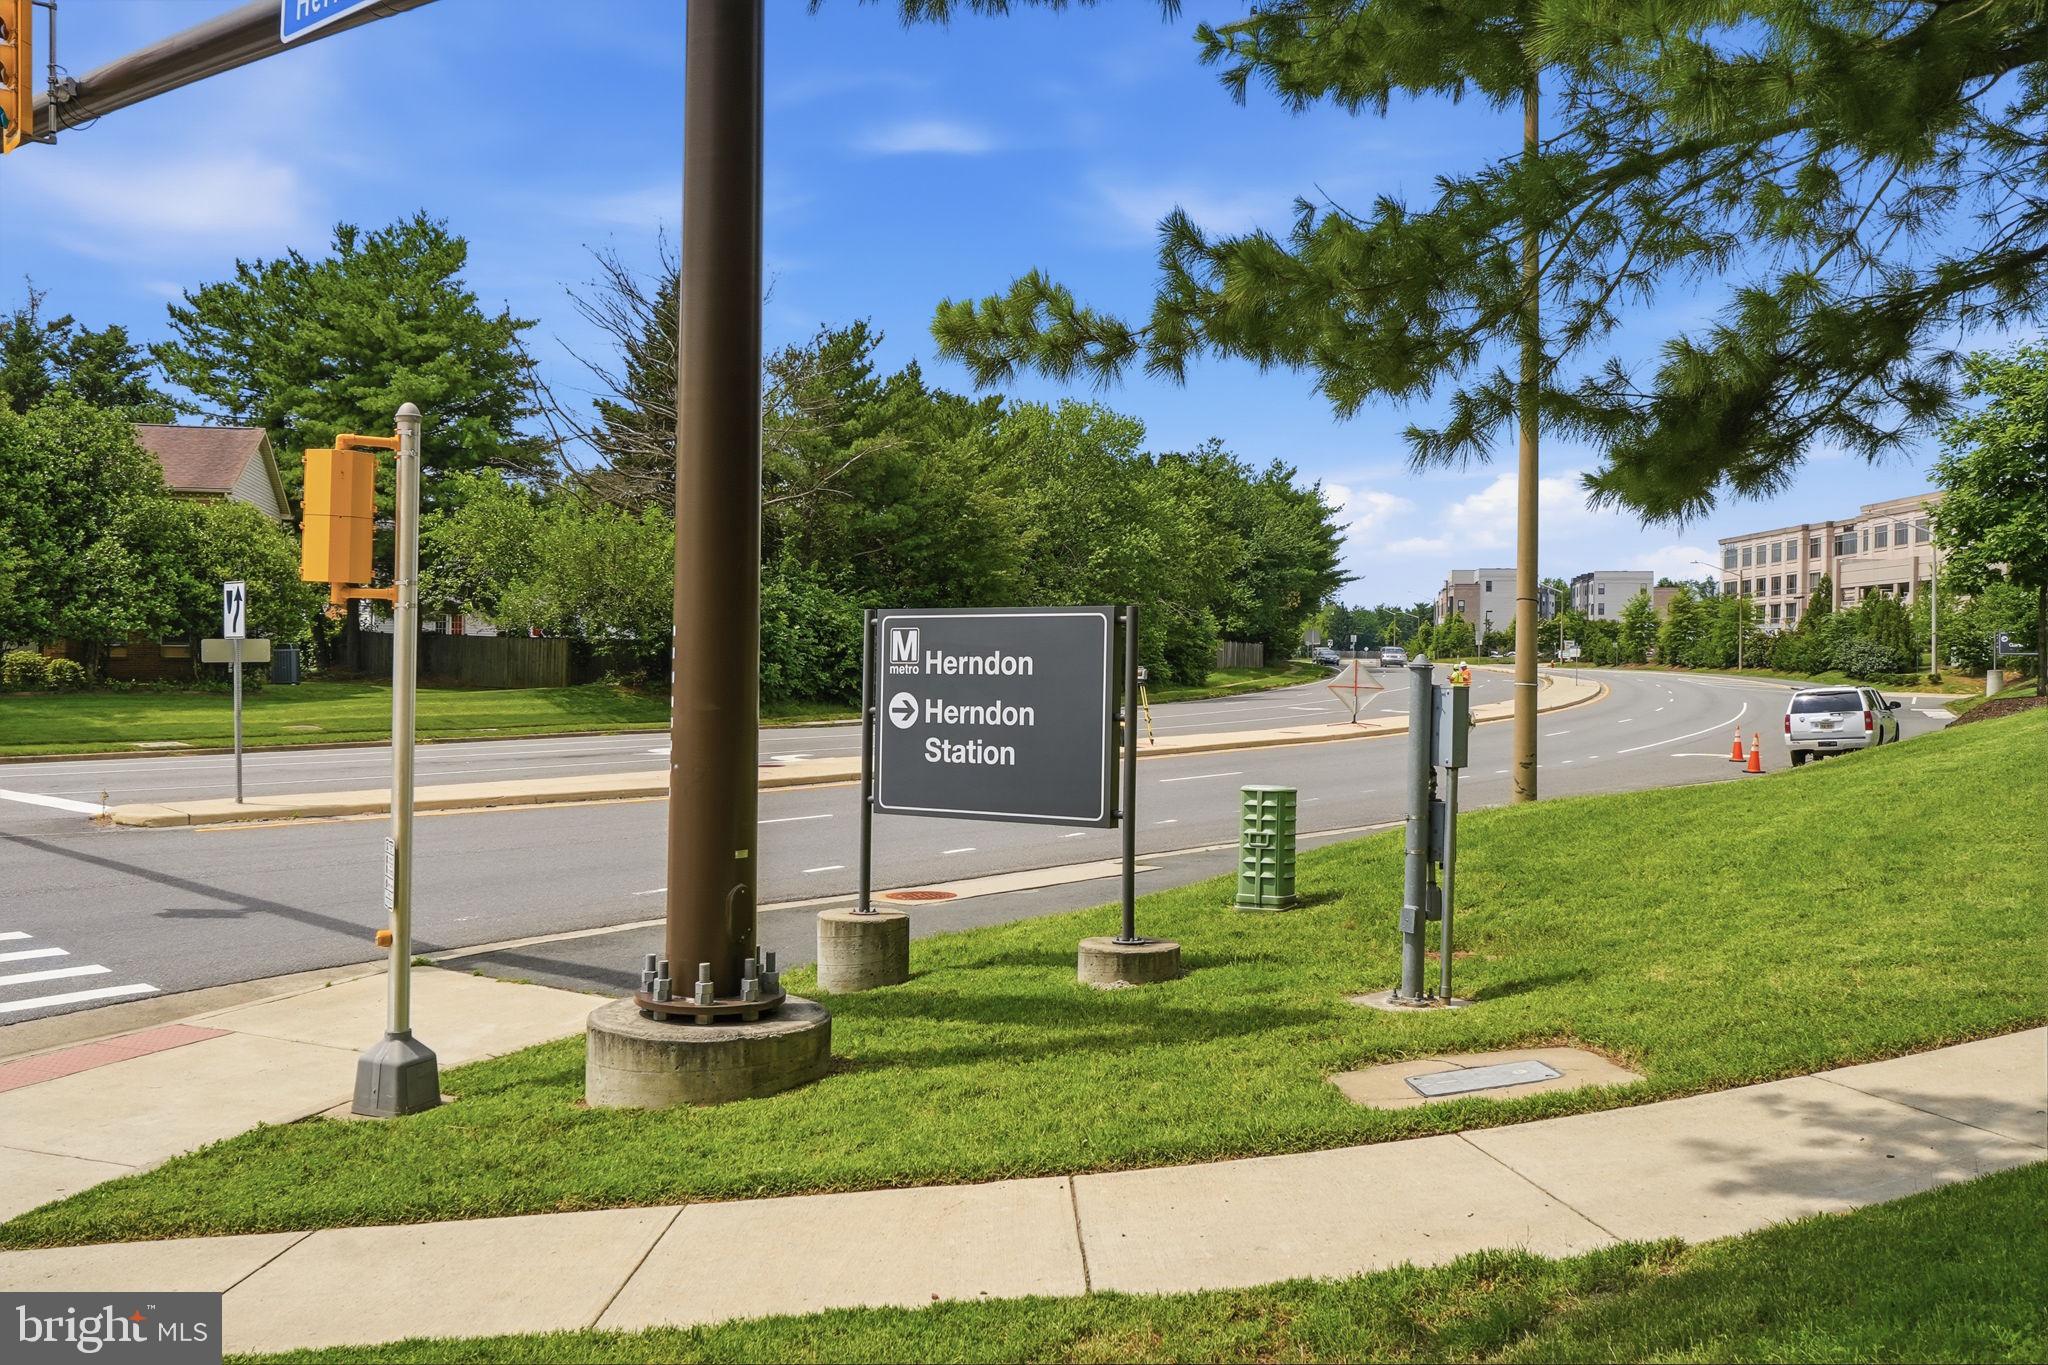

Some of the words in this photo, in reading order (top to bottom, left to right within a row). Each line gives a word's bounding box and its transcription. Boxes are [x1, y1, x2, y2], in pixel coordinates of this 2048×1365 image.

[892, 630, 918, 662] M
[889, 664, 920, 675] metro
[925, 650, 1034, 676] Herndon
[925, 699, 1035, 726] Herndon
[924, 737, 1015, 766] Station
